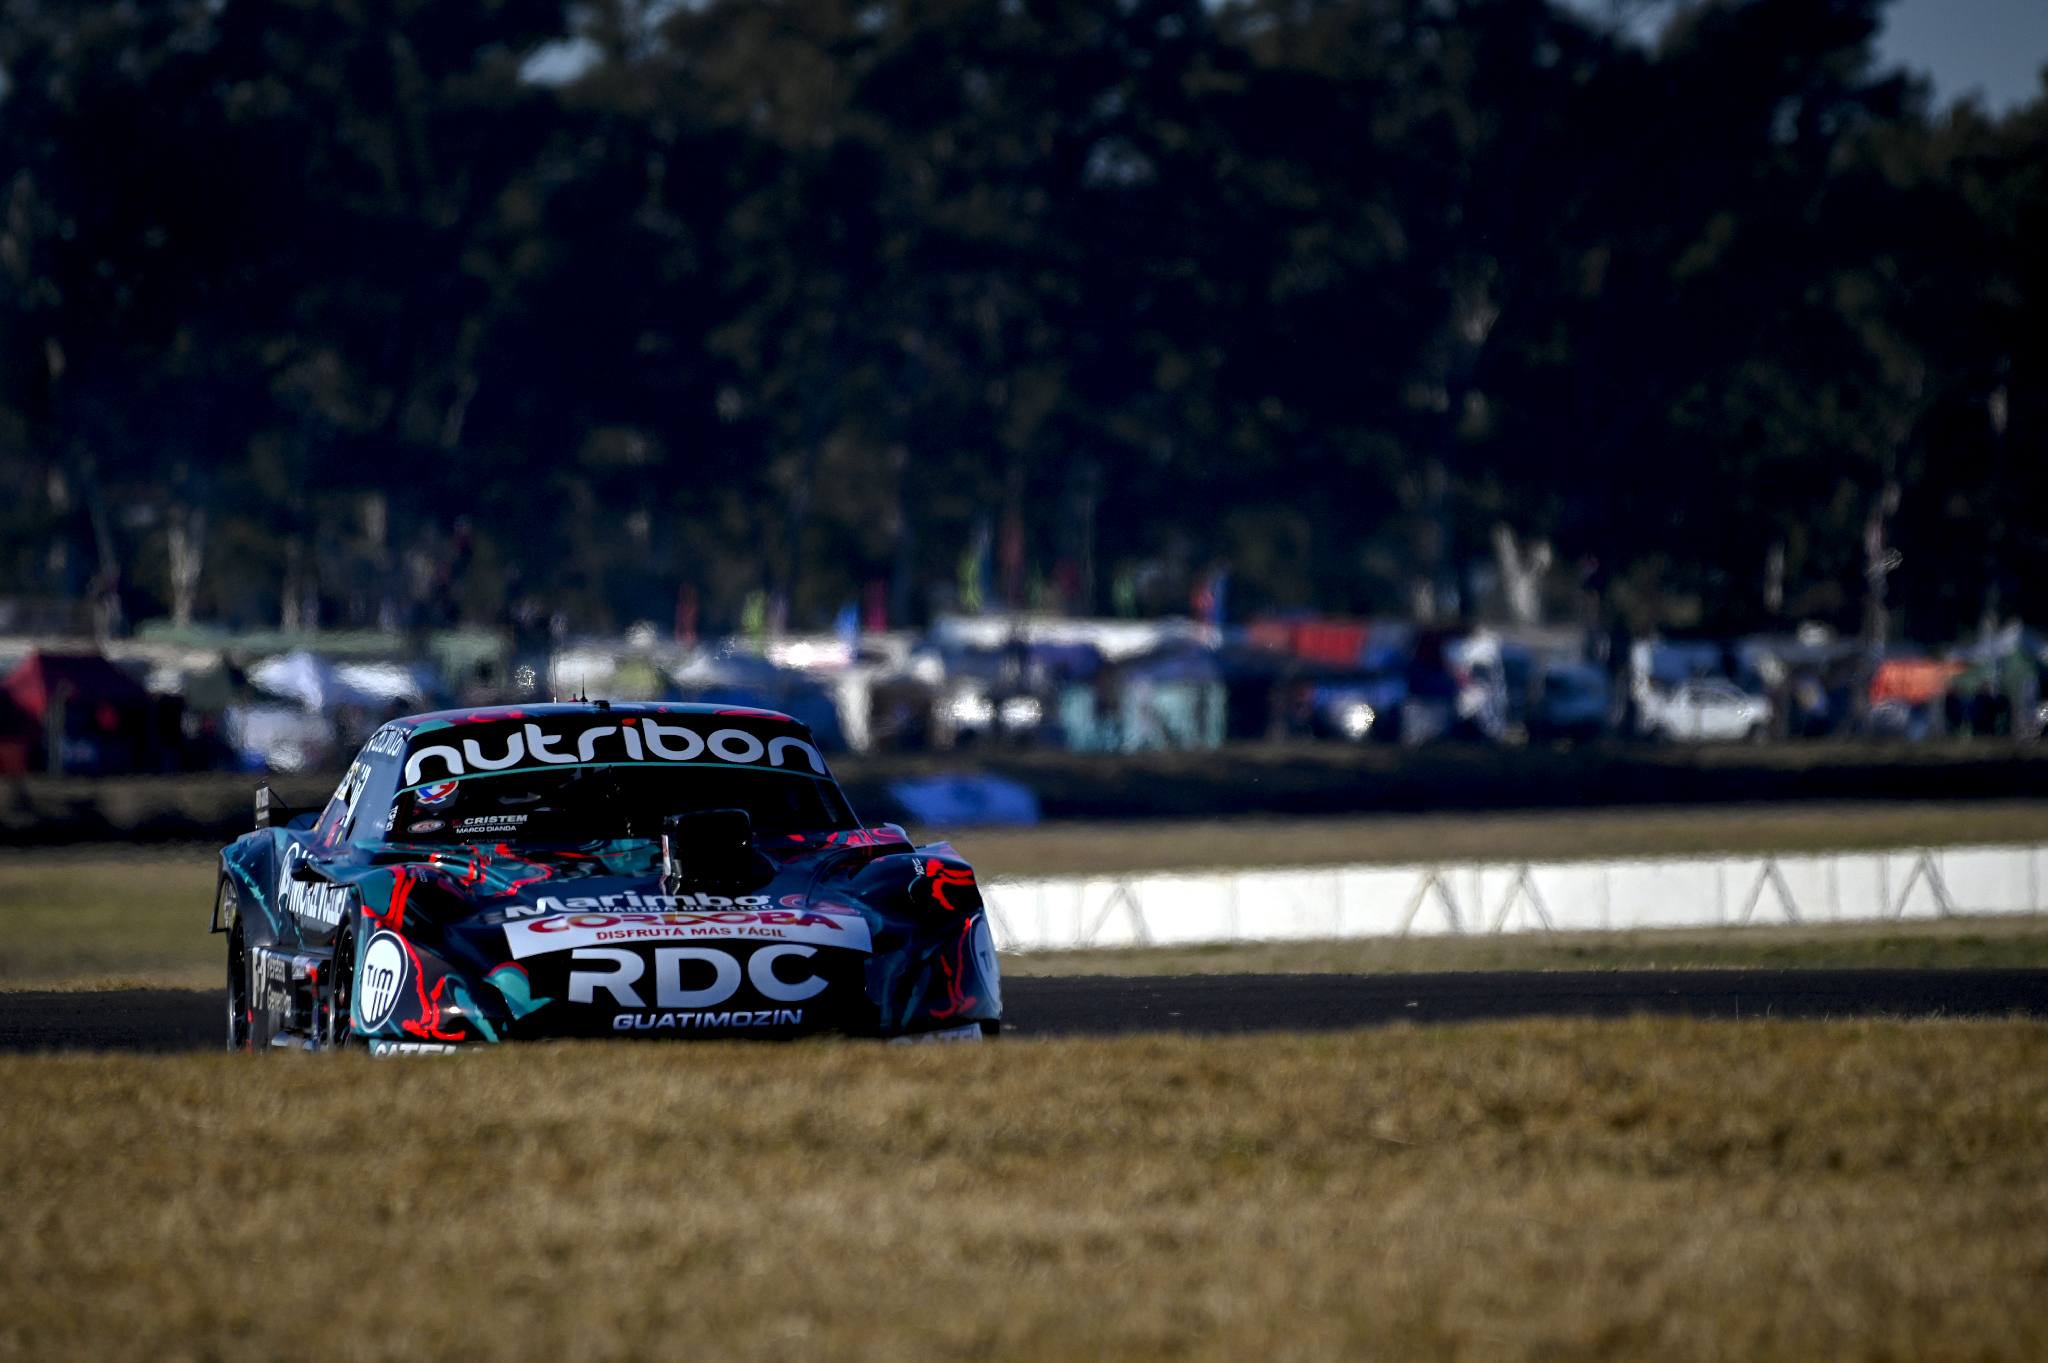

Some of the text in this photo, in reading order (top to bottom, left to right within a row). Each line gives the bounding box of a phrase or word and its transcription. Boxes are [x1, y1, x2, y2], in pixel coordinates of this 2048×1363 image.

[405, 718, 826, 786] nutribon
[456, 825, 485, 834] MARCO
[464, 814, 528, 825] CRISTEM
[505, 890, 771, 918] Marimba
[528, 911, 844, 934] CORDOBA
[568, 944, 829, 1008] RDC
[612, 1009, 803, 1031] GUATIMOZIN
